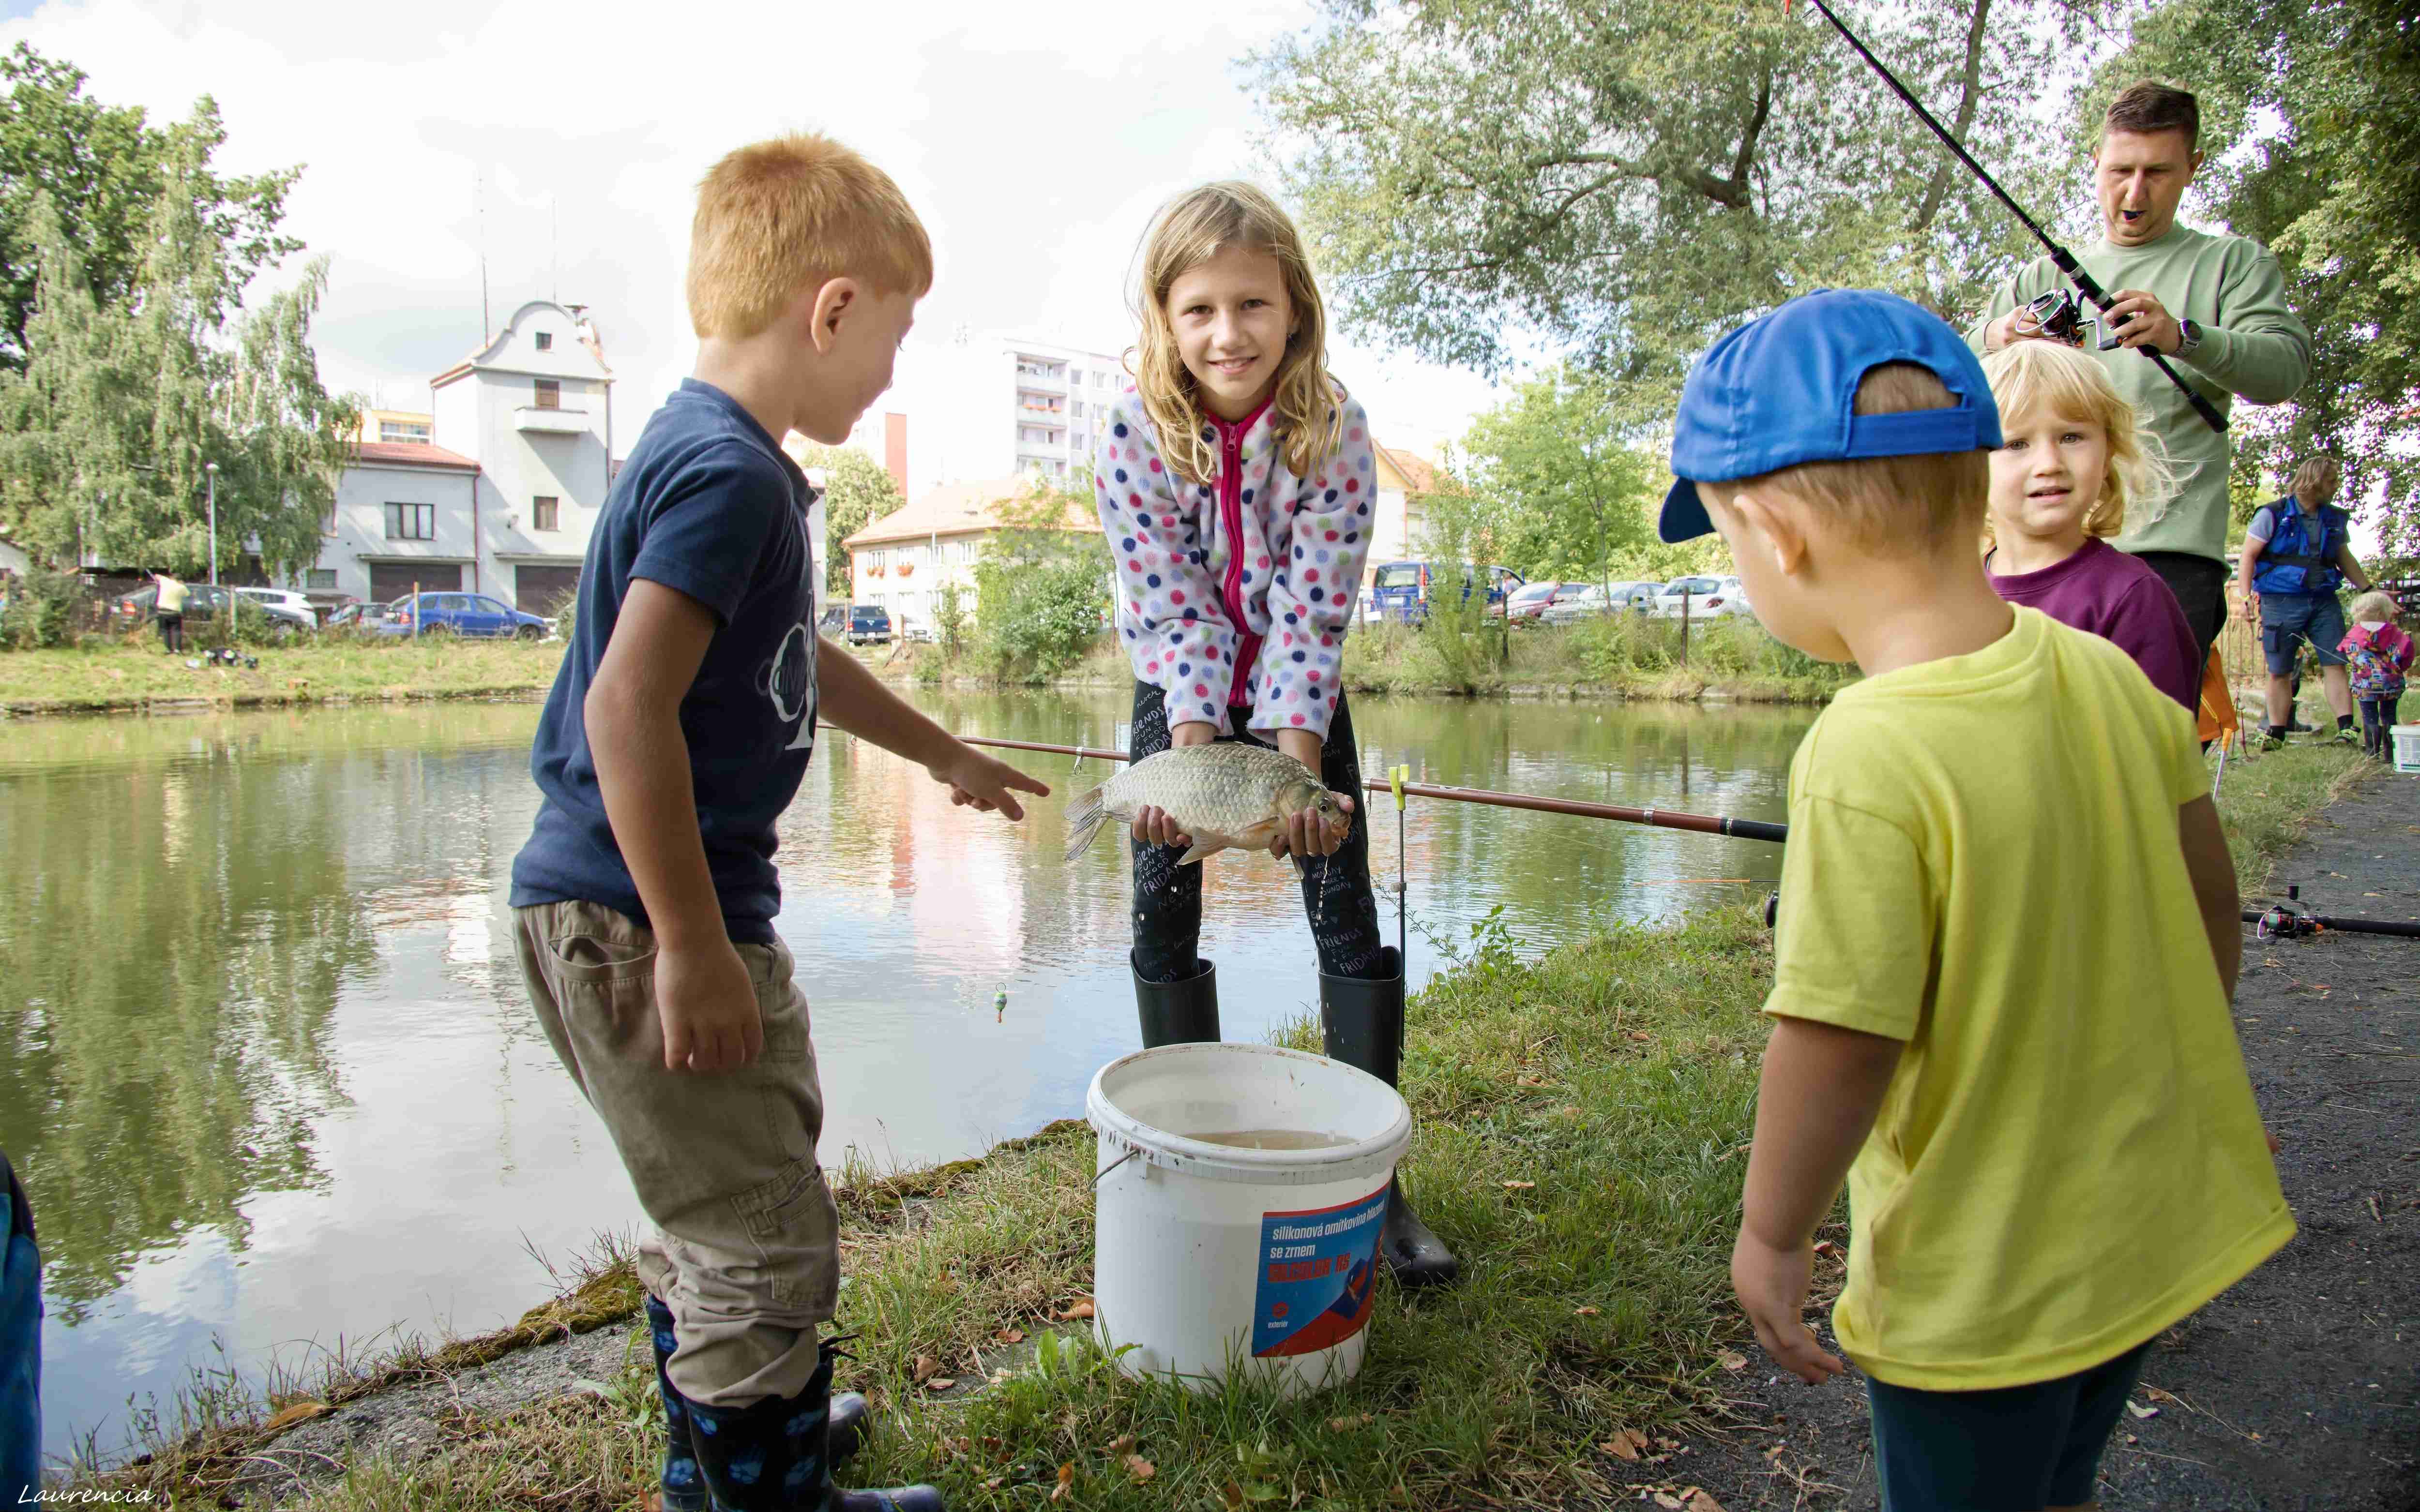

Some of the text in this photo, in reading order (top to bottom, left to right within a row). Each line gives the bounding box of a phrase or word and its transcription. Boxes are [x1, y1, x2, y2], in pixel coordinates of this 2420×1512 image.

[1143, 725, 1165, 744] FOOD
[1140, 733, 1171, 758] FRIDA
[1146, 858, 1169, 878] FOOD
[1272, 1222, 1324, 1240] silikonová
[1270, 1244, 1317, 1259] se zrnem
